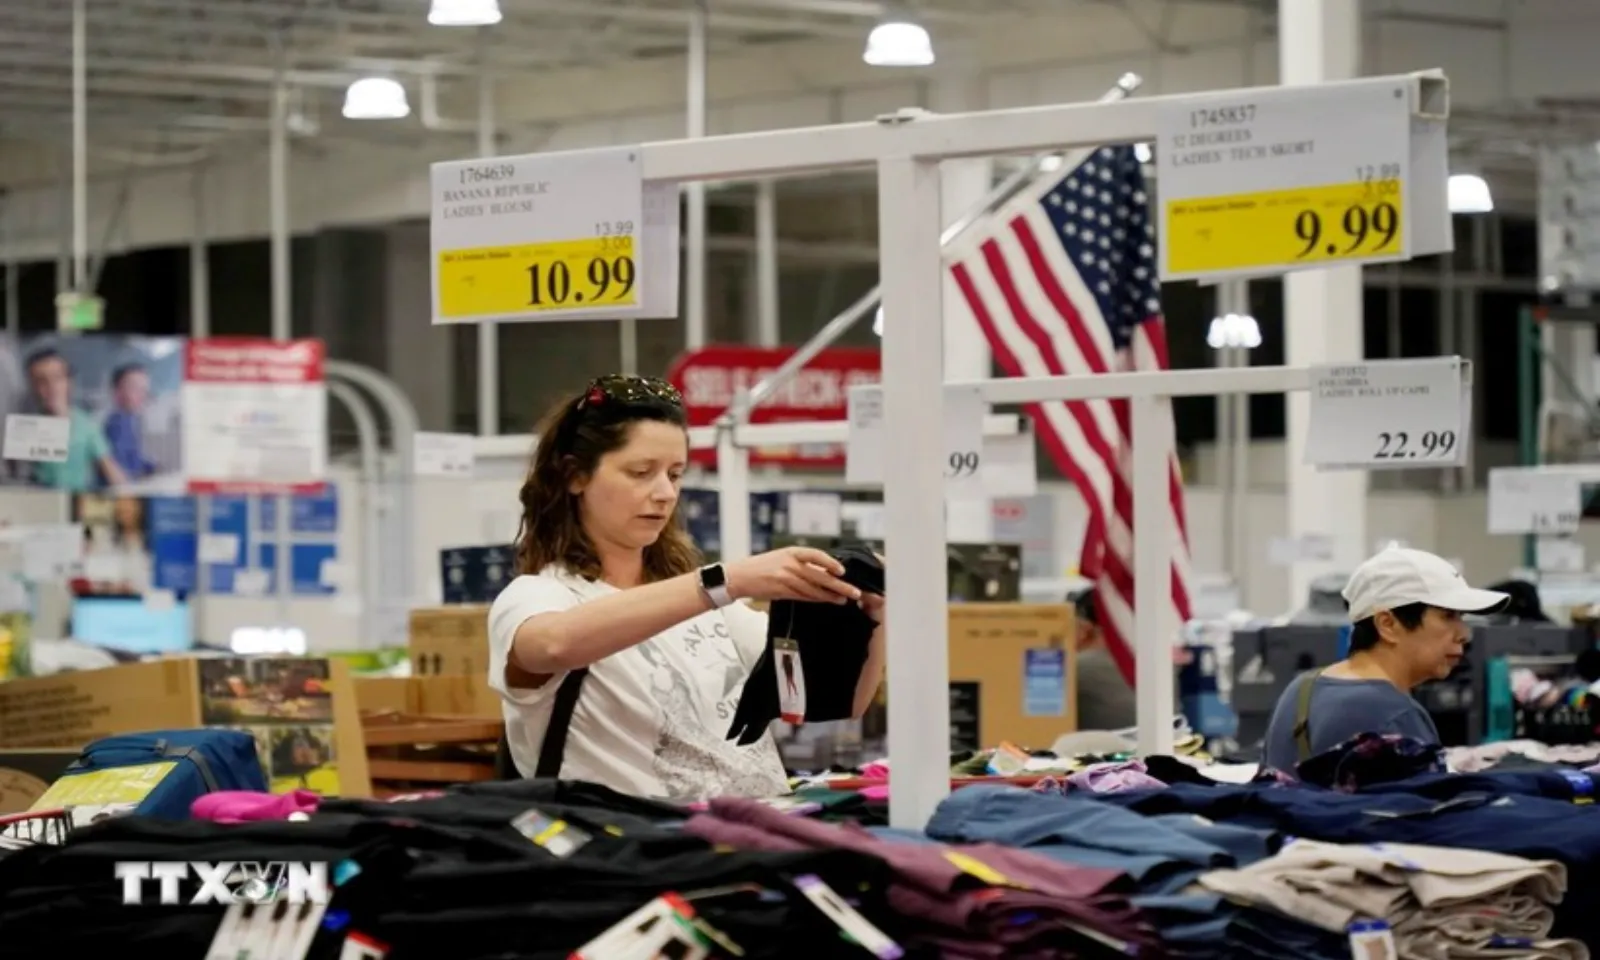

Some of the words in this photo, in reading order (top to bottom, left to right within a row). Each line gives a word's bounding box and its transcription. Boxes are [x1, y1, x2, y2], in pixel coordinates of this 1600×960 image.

[460, 164, 515, 184] 1764639
[494, 180, 550, 197] REPUBLIC
[595, 220, 634, 236] 13.99
[1295, 202, 1398, 258] 9.99
[526, 255, 635, 305] 10.99
[1373, 430, 1456, 459] 22.99
